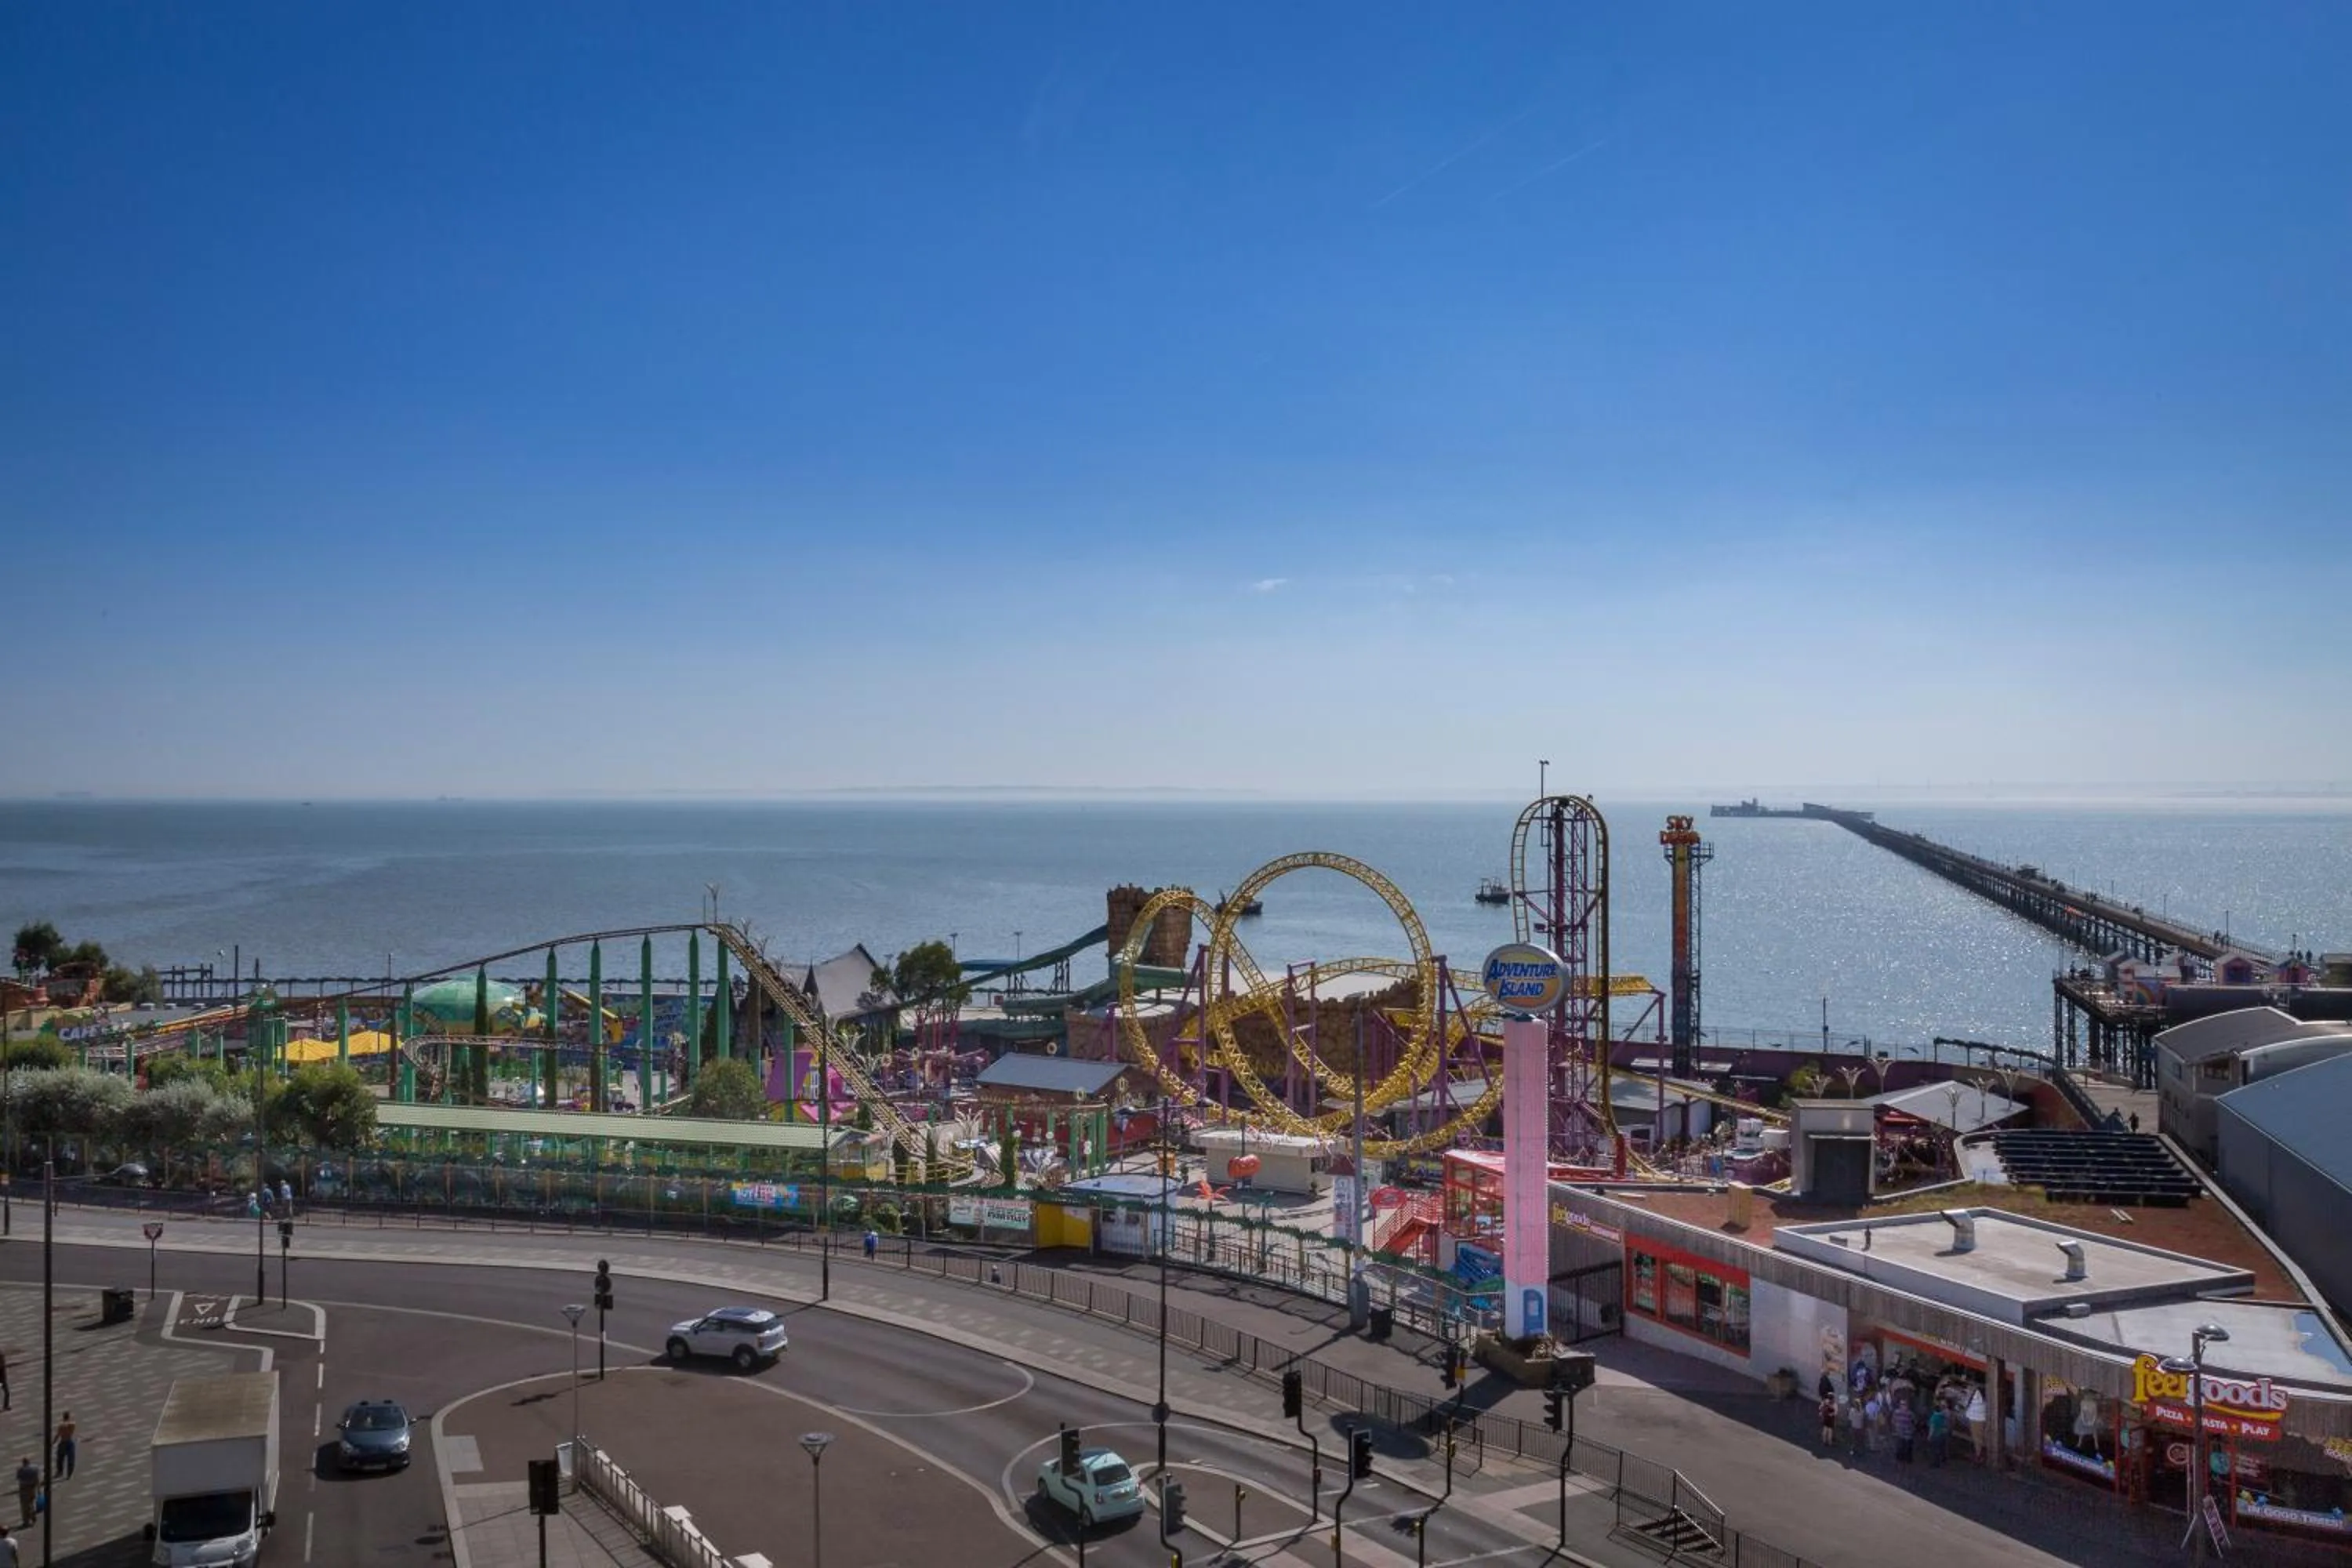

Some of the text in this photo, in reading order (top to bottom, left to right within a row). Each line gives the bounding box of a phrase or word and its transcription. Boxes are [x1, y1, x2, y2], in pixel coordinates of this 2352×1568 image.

[1485, 960, 1556, 982] ADVENTURE
[1498, 978, 1544, 1000] ISLAND
[2156, 1406, 2270, 1436] PIZZA ASTA PLAY
